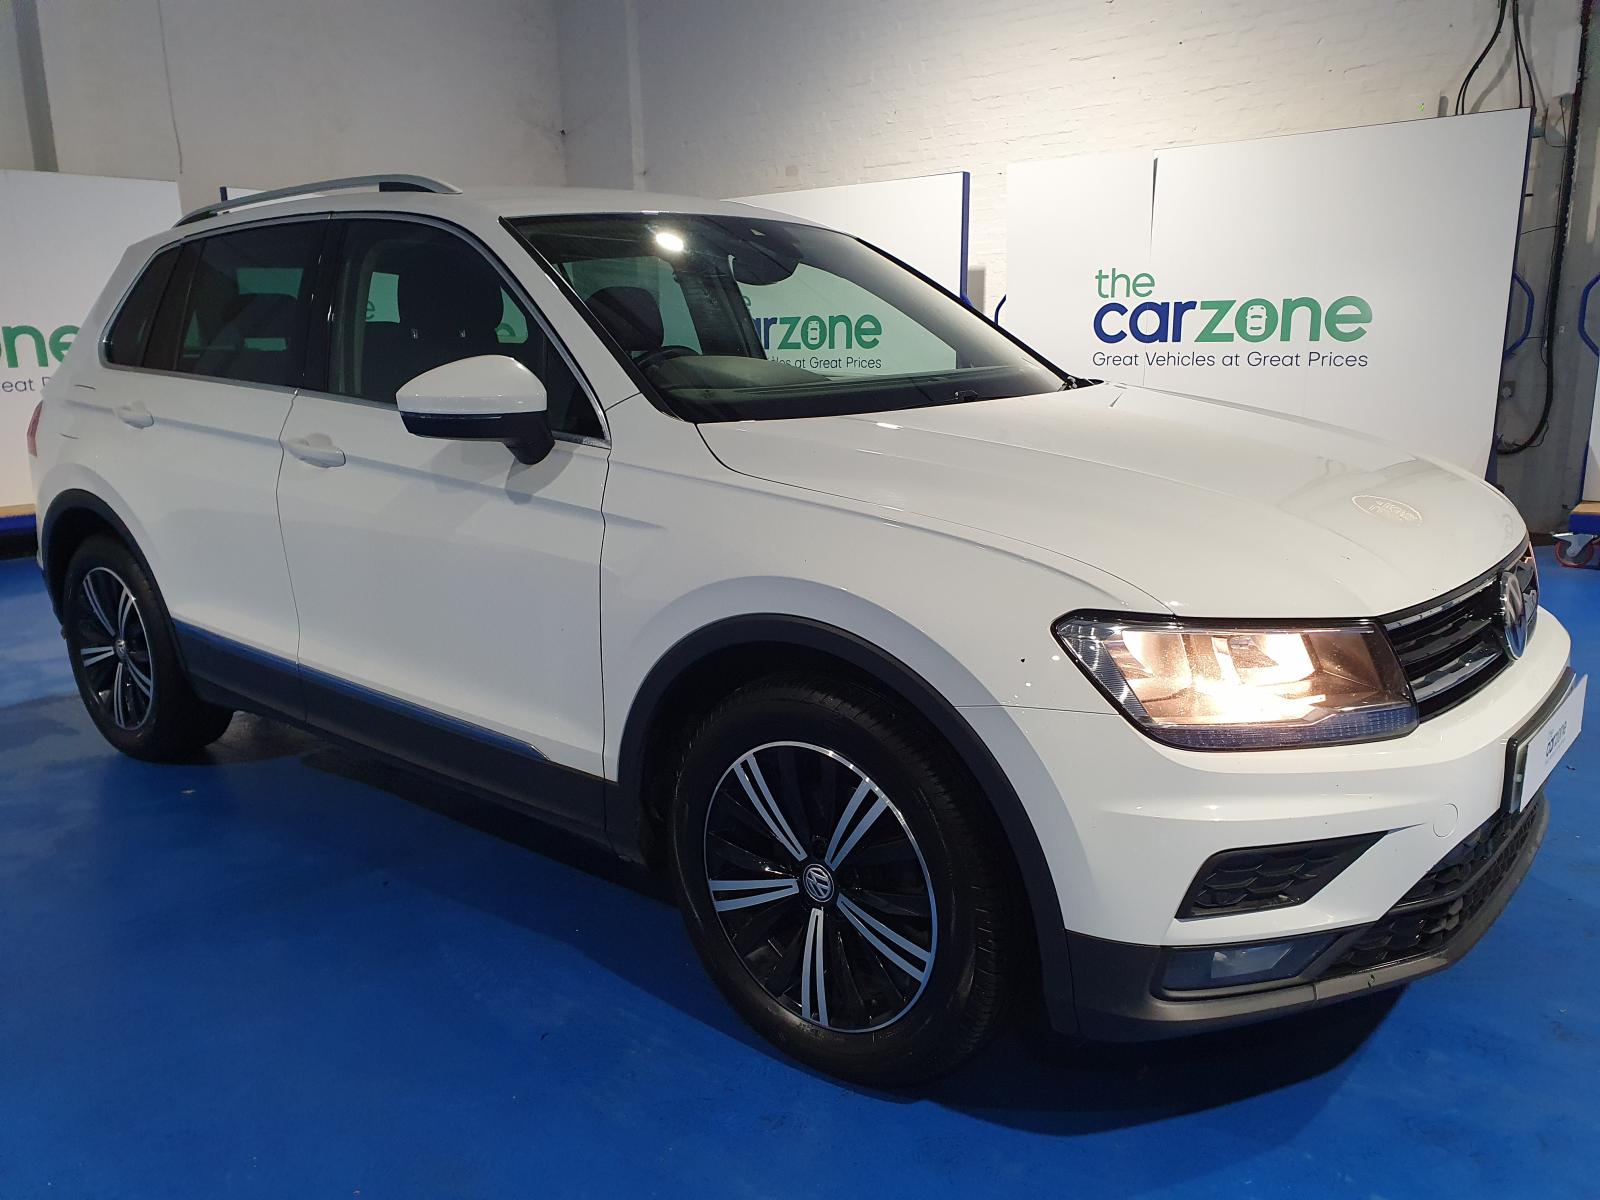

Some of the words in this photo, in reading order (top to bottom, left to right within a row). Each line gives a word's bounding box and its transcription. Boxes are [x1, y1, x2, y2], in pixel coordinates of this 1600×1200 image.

[1095, 267, 1155, 299] the
[1093, 295, 1373, 344] carzone
[794, 359, 806, 369] at
[809, 356, 842, 369] Great
[846, 356, 882, 369] Prices
[1092, 351, 1139, 367] Great
[1145, 351, 1216, 367] Vehicles
[1221, 353, 1240, 367] at
[1246, 351, 1301, 367] Great
[1308, 351, 1369, 367] Prices
